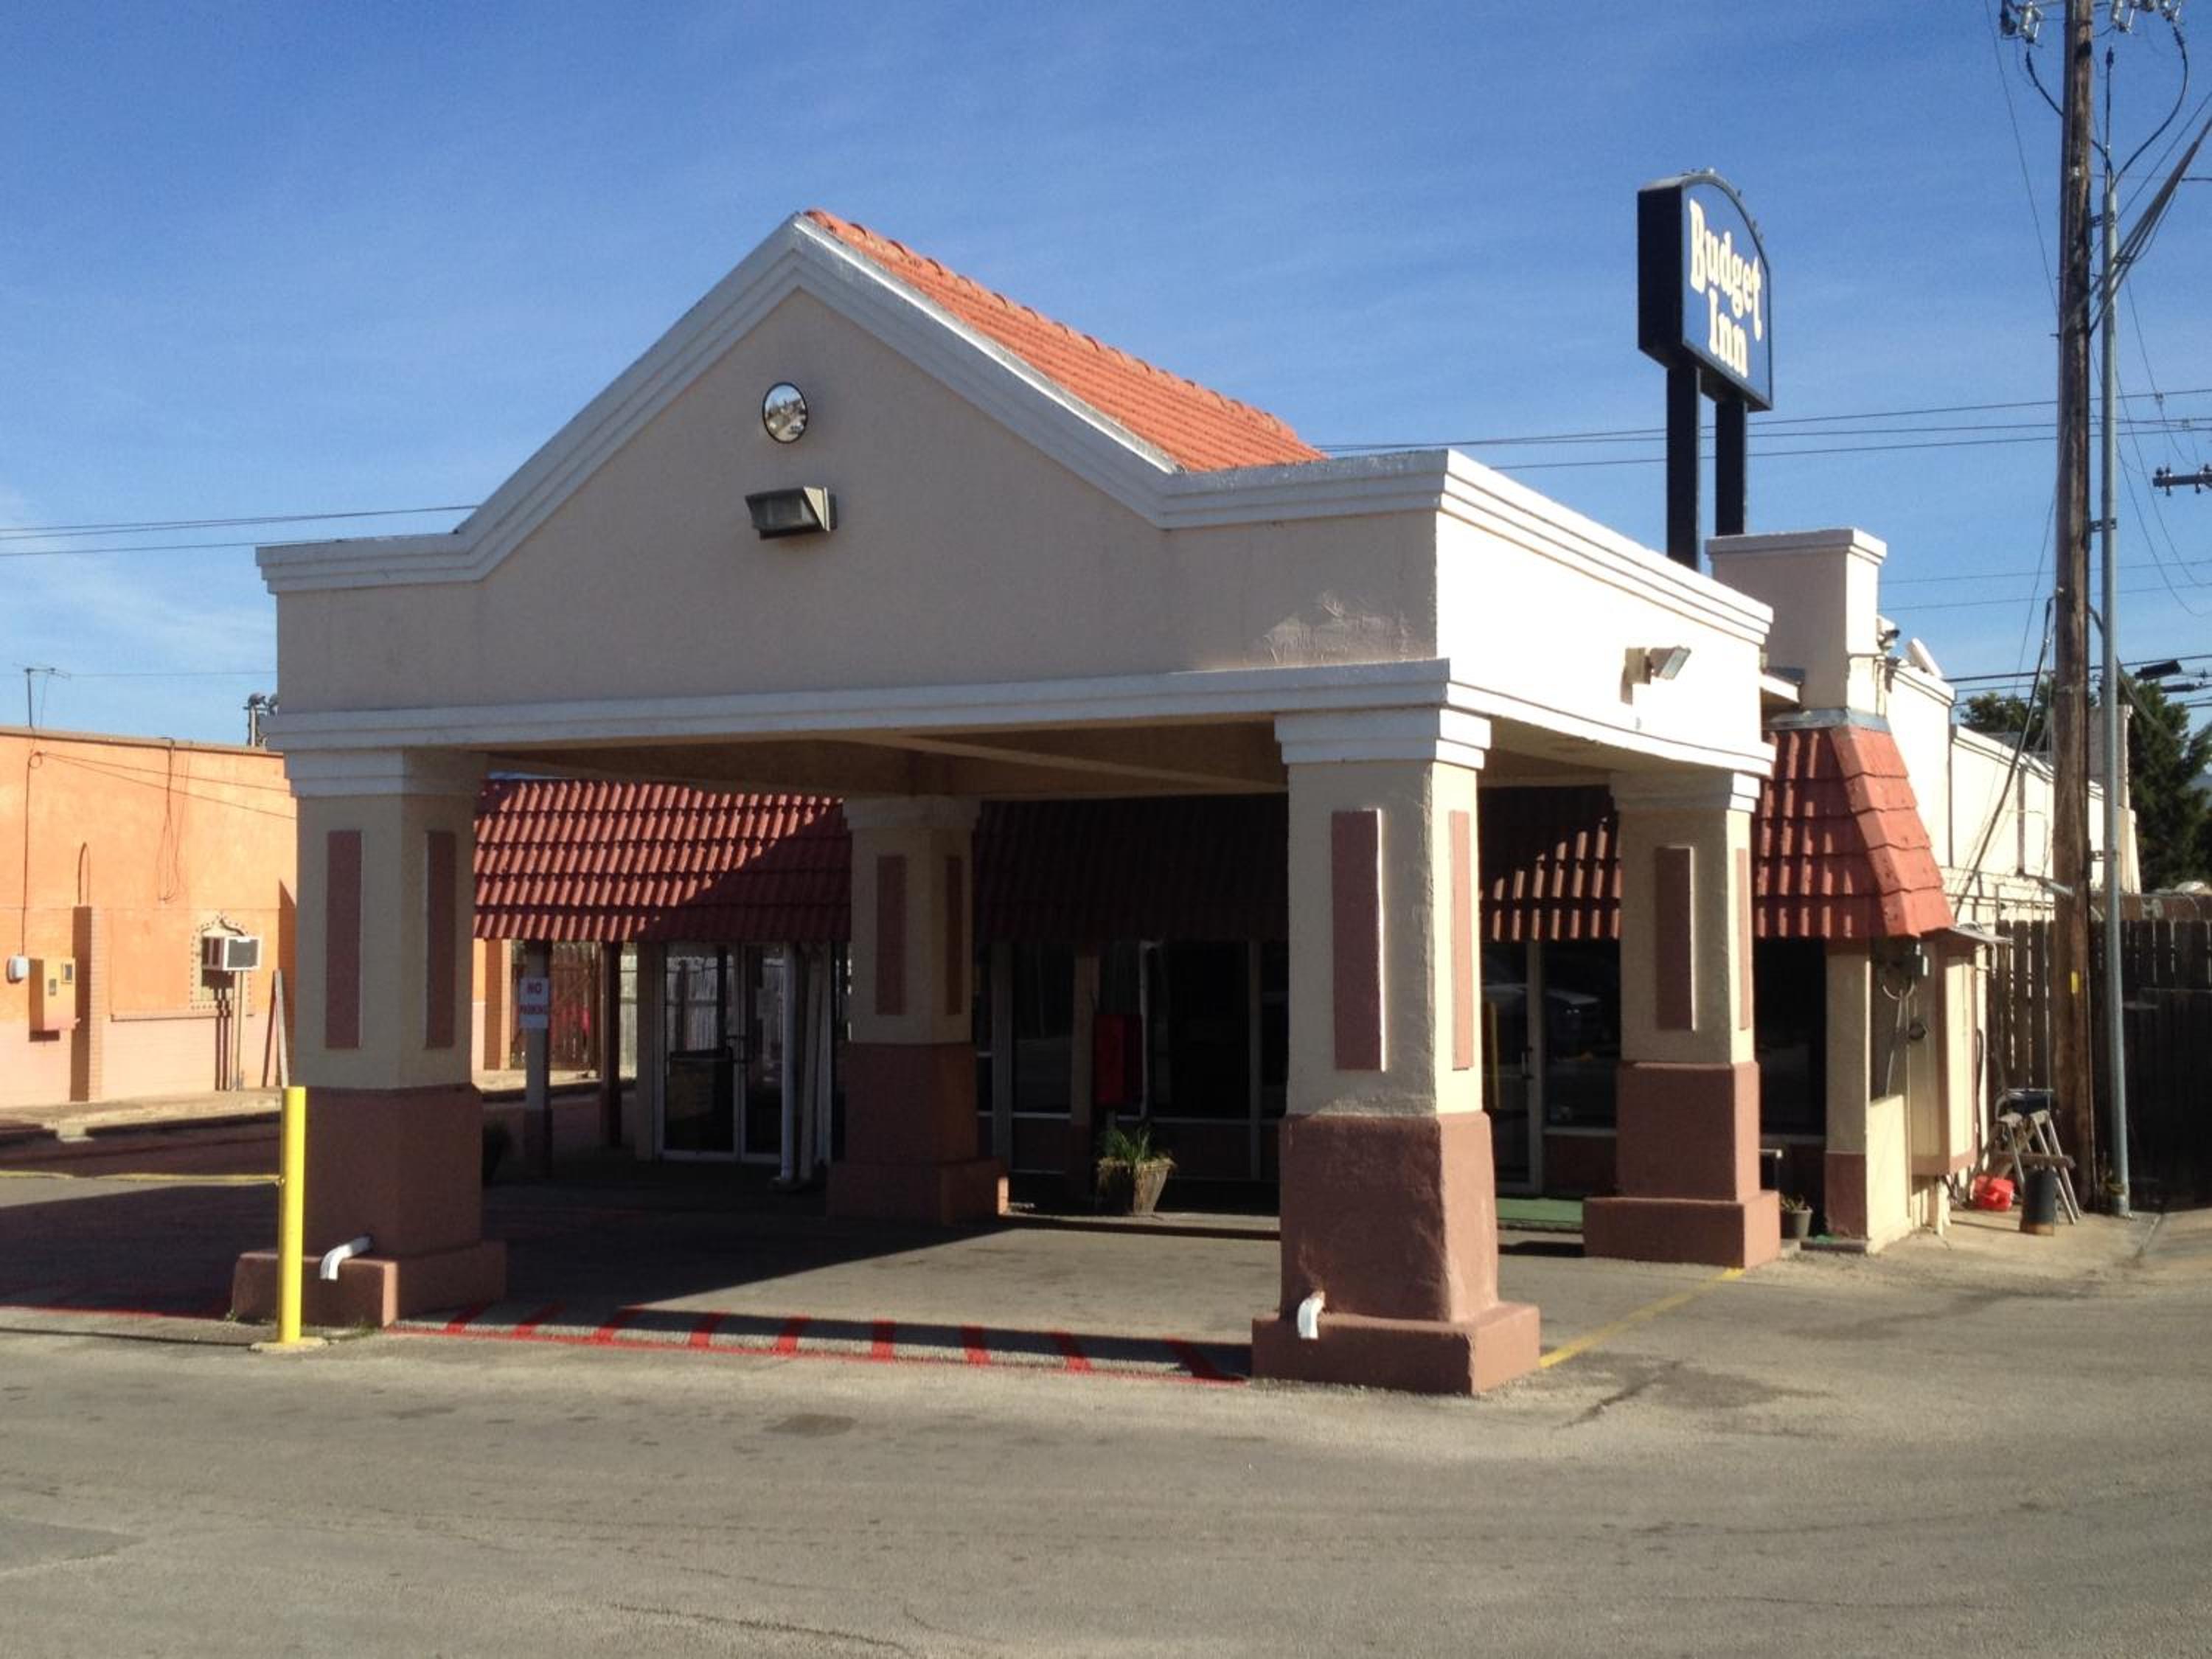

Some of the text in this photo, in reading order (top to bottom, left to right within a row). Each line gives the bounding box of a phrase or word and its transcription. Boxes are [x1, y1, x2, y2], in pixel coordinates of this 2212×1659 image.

[1689, 198, 1762, 341] Budget
[1708, 288, 1747, 378] Inn
[526, 981, 543, 995] NO
